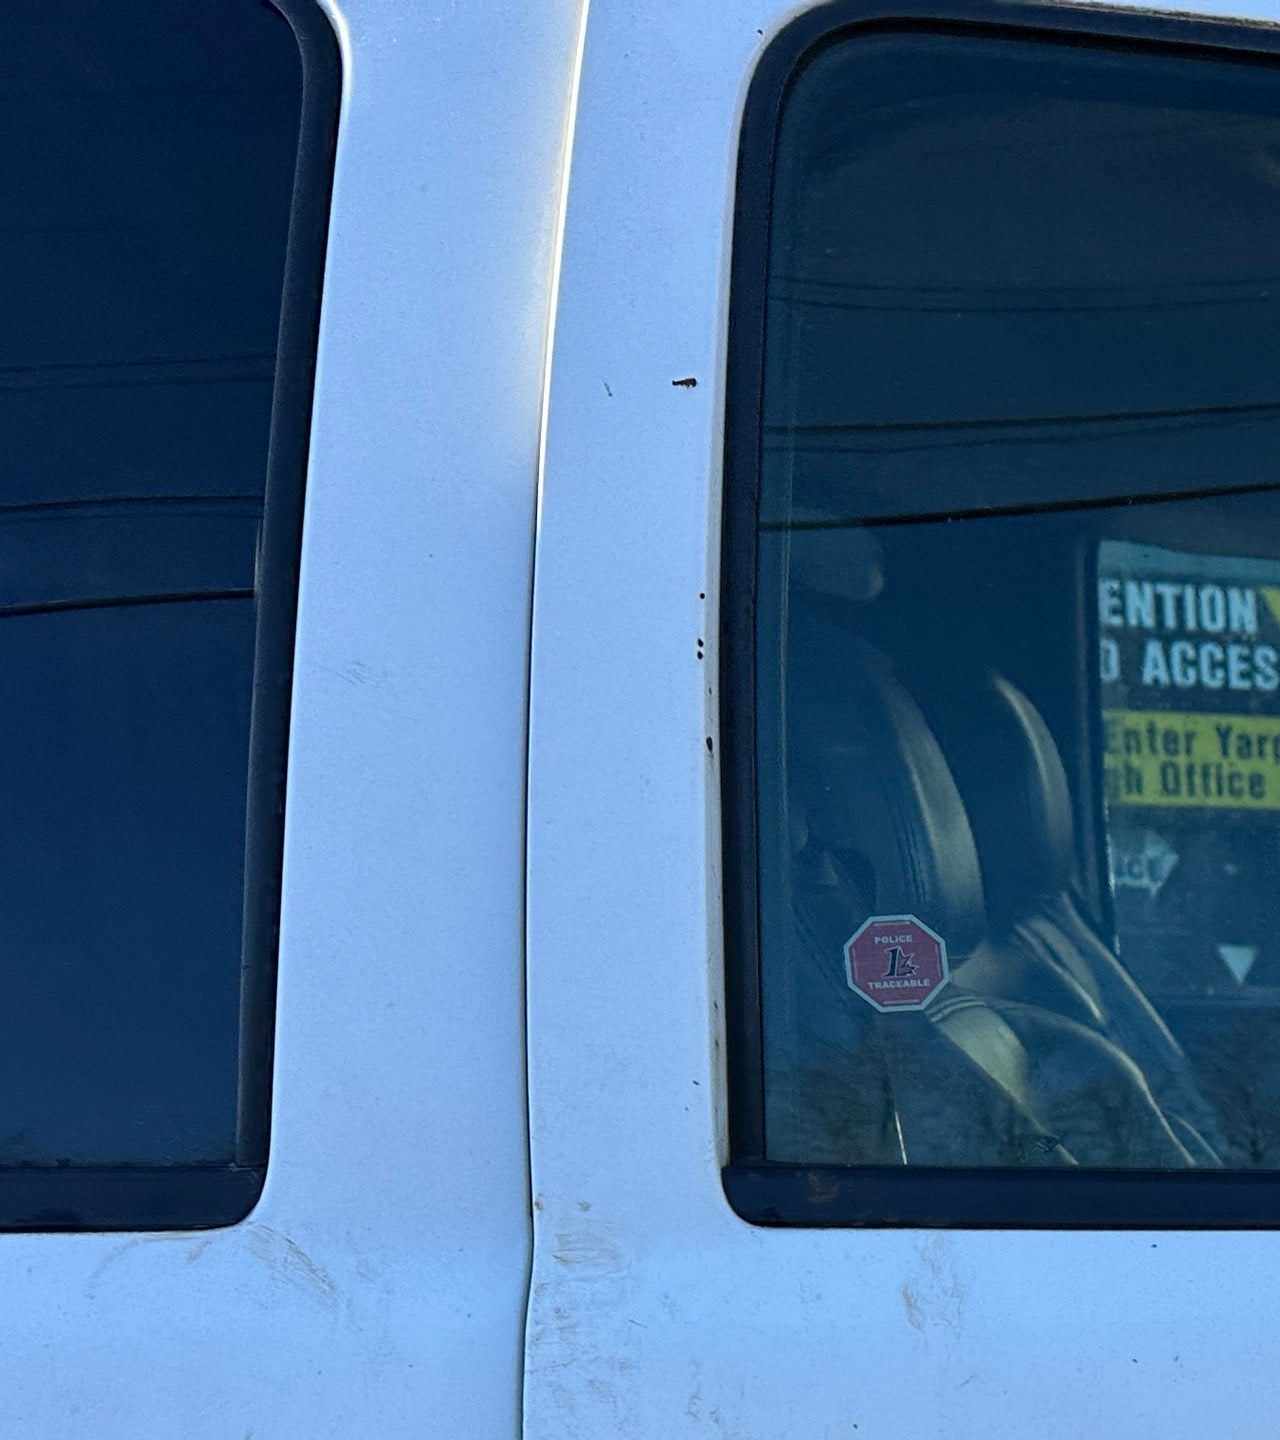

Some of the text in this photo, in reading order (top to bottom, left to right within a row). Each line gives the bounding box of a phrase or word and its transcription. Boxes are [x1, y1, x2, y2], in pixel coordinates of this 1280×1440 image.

[1159, 761, 1266, 800] Office
[874, 935, 912, 944] POLICE
[868, 979, 930, 990] TRACEABLE
